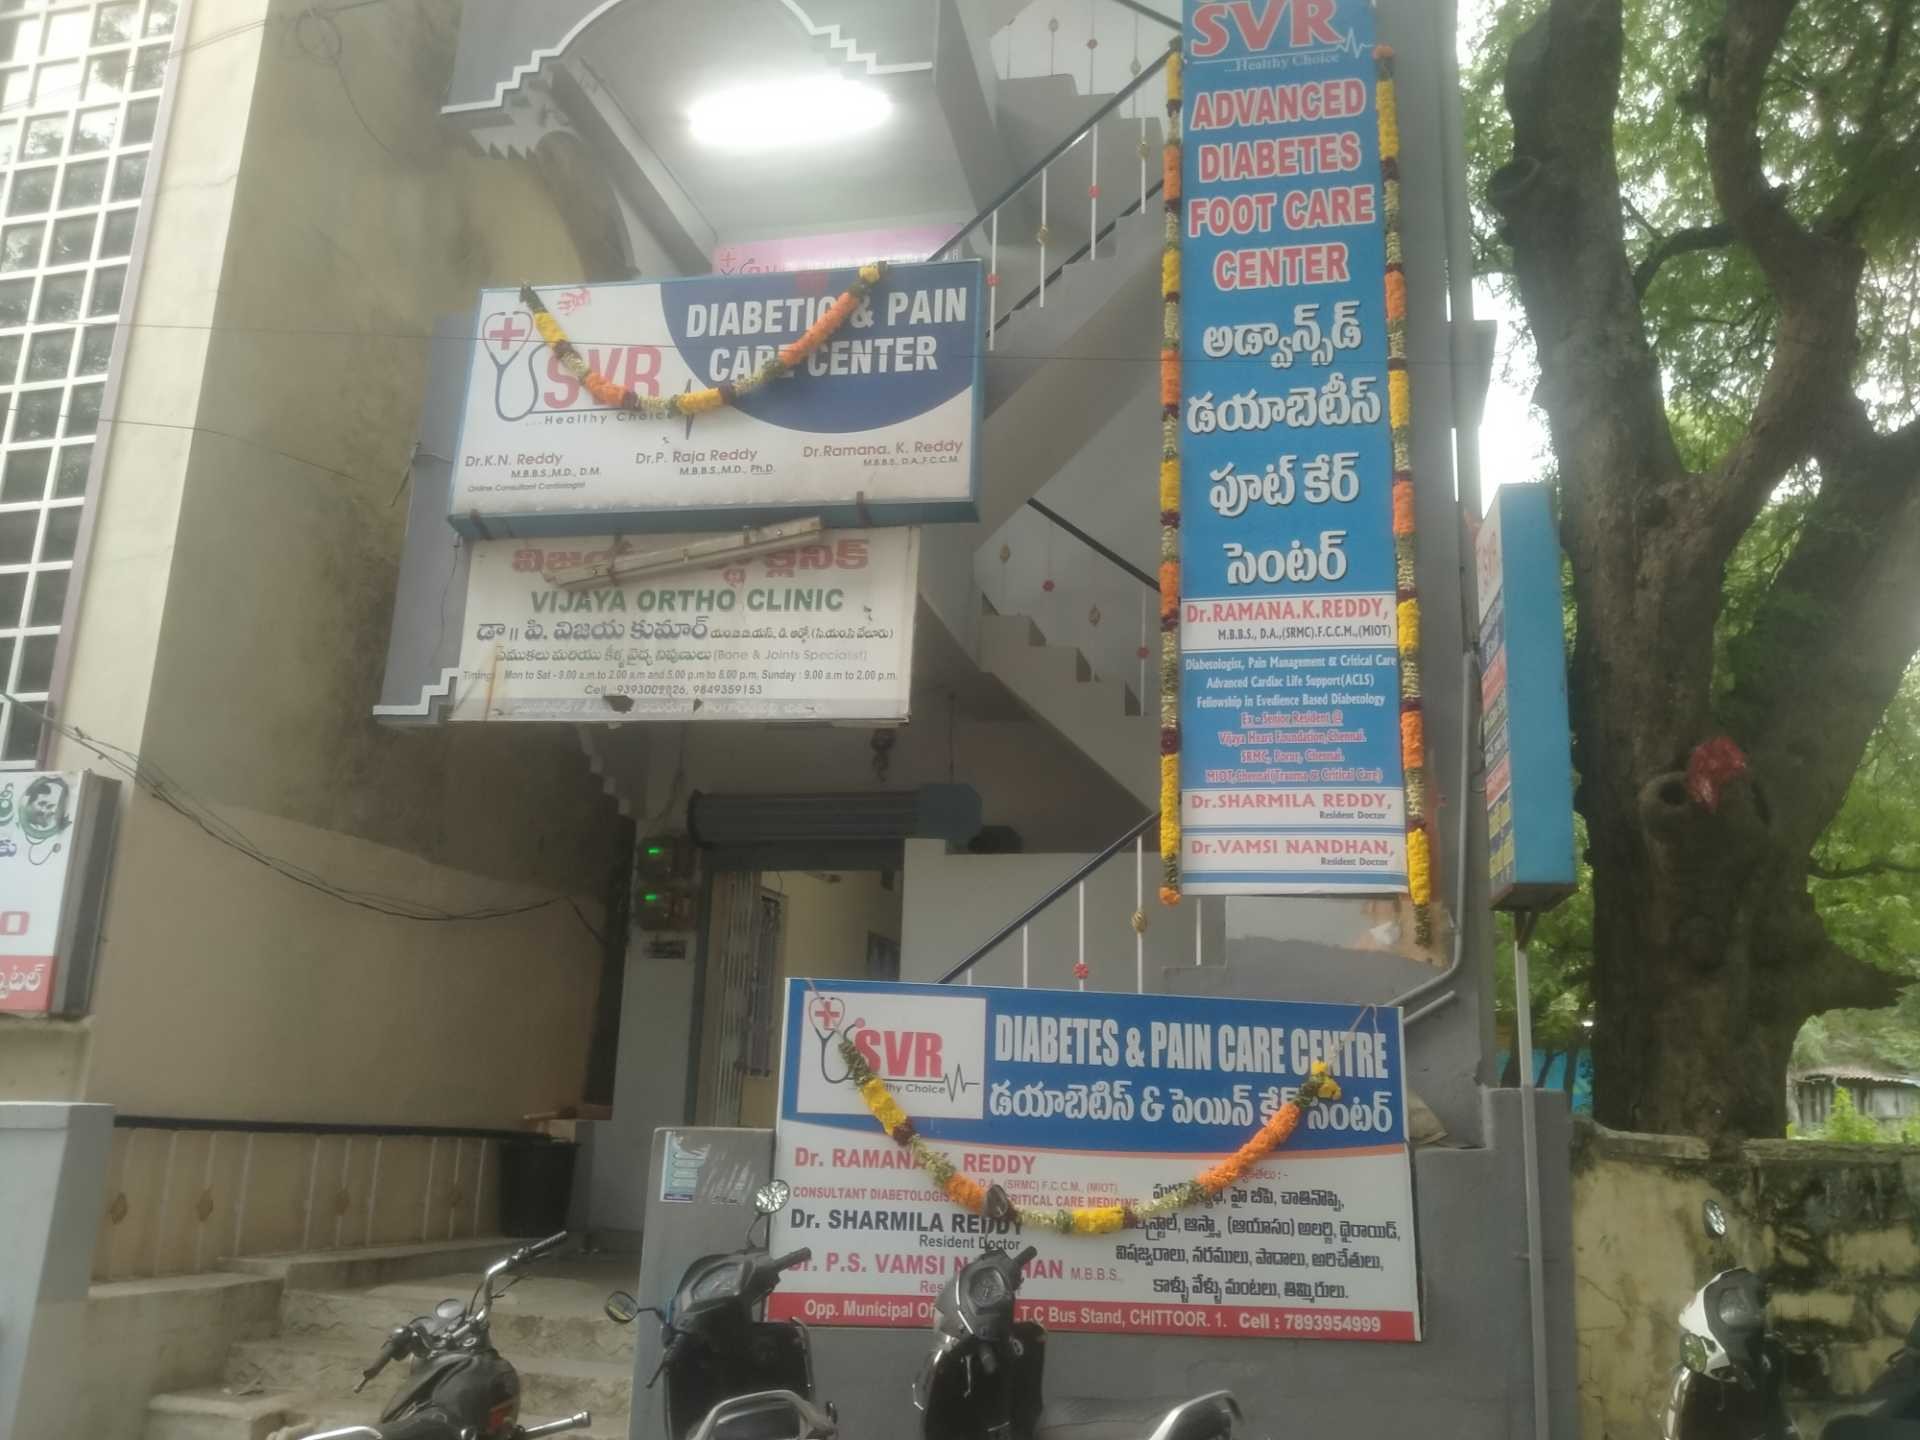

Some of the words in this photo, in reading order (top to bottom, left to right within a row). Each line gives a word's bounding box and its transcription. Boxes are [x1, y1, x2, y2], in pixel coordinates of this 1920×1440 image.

[1191, 0, 1345, 57] SVR
[1292, 52, 1341, 66] Choice
[1190, 78, 1366, 131] ADVANCED
[1199, 132, 1362, 183] DIABETES
[1188, 192, 1277, 238] FOOT
[1283, 184, 1375, 230] CARE
[1213, 243, 1349, 291] CENTER
[887, 287, 967, 326] PAIN
[808, 336, 939, 377] CENTER
[672, 450, 705, 464] Raja
[710, 448, 758, 463] Reddy
[914, 440, 964, 455] Reddy
[516, 452, 564, 467] Reddy
[1302, 452, 1361, 504] కేర్
[1223, 530, 1348, 586] సెంటర్
[531, 589, 626, 613] VIJAYA
[637, 588, 737, 612] ORTHO
[747, 588, 844, 612] CLINIC
[553, 619, 626, 641] విజయ
[630, 615, 709, 641] కుమార్
[765, 649, 800, 661] Joints
[1248, 657, 1267, 669] Pain
[1270, 656, 1326, 671] Management
[1328, 656, 1339, 667] &
[1341, 654, 1373, 667] Critical
[1375, 654, 1397, 667] Care
[504, 670, 524, 680] Mon
[525, 670, 535, 680] to
[537, 670, 552, 681] Sat
[761, 669, 798, 682] Sunday
[845, 670, 855, 681] to
[1206, 677, 1248, 690] Advanced
[1251, 675, 1284, 688] Cardiac
[1286, 675, 1303, 688] Life
[1196, 695, 1243, 709] Fellowship
[1303, 694, 1328, 706] Based
[1331, 692, 1386, 707] Diabetology
[1191, 793, 1315, 809] Dr.SHARMILA
[1323, 792, 1392, 810] REDDY,
[1319, 810, 1355, 820] Resident
[1357, 810, 1387, 820] Doctor
[1191, 839, 1279, 855] Dr.VAMSI
[1286, 839, 1394, 857] NANDHAN,
[1320, 857, 1356, 867] Resident
[1359, 857, 1389, 867] Doctor
[855, 1029, 943, 1079] SVR
[995, 1014, 1120, 1067] DIABETES
[1125, 1027, 1145, 1068] &
[1151, 1022, 1212, 1071] PAIN
[1218, 1024, 1286, 1074] CARE
[1291, 1028, 1389, 1079] CENTRE
[905, 1083, 946, 1095] Choice
[795, 1147, 824, 1168] Dr.
[963, 1153, 1036, 1175] REDDY
[793, 1186, 866, 1200] CONSULTANT
[1056, 1196, 1085, 1208] CARE
[790, 1209, 820, 1229] Dr.
[828, 1209, 944, 1232] SHARMILA
[919, 1234, 975, 1249] Resident
[979, 1236, 1021, 1250] Doctor
[825, 1252, 867, 1273] P.S.
[876, 1253, 945, 1276] VAMSI
[804, 1302, 840, 1319] Opp.
[843, 1303, 914, 1321] Municipal
[1048, 1306, 1077, 1323] Bus
[1080, 1307, 1126, 1328] Stand,
[1130, 1309, 1212, 1327] CHITTOOR.
[1239, 1312, 1270, 1329] Cell
[1284, 1313, 1382, 1333] 7893954999
